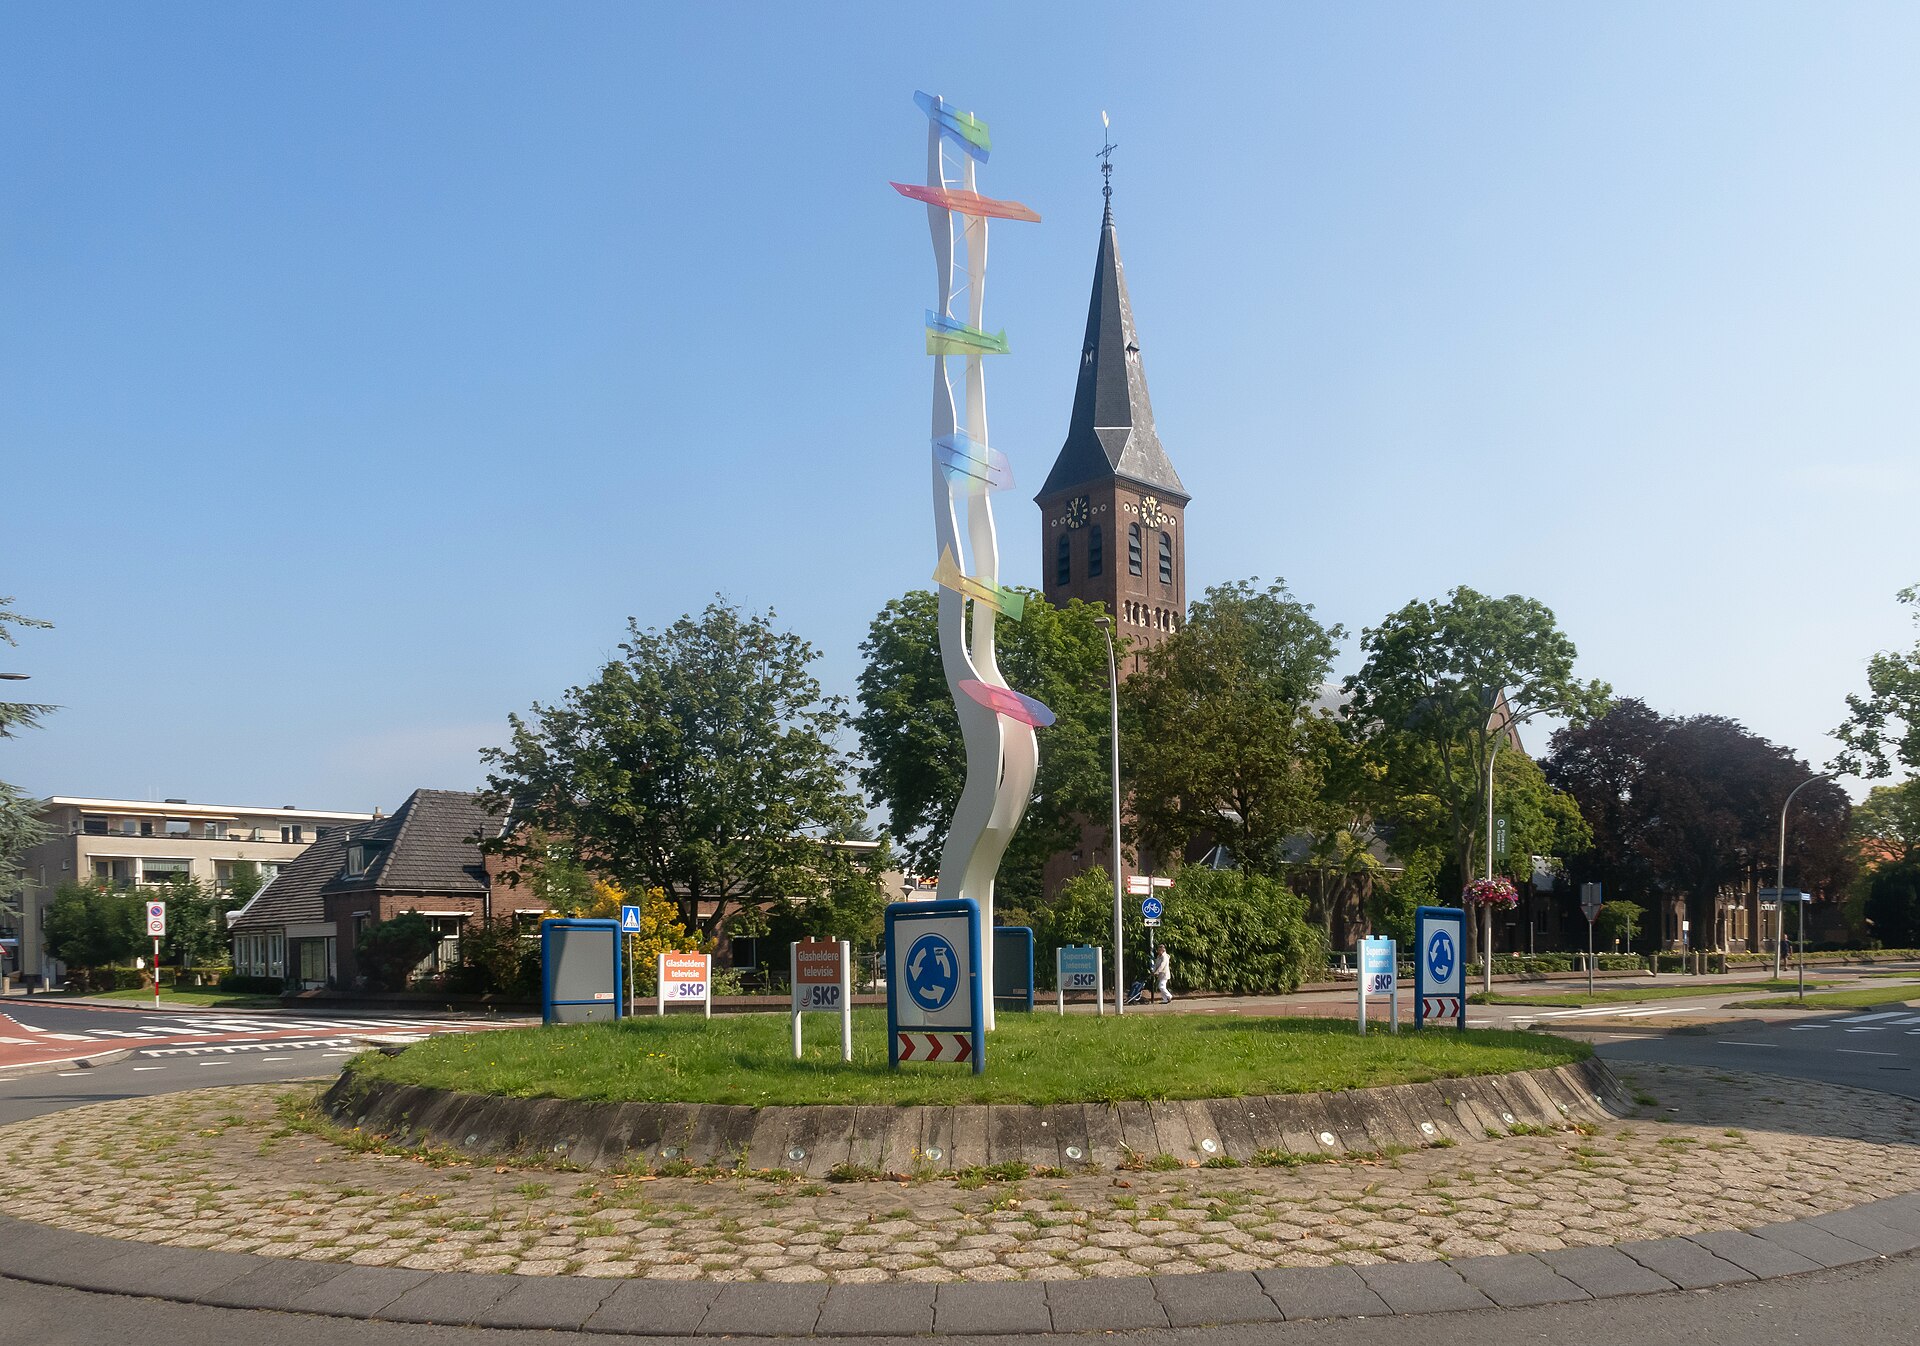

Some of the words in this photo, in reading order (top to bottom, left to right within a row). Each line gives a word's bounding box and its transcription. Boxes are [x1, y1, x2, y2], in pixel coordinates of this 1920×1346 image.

[798, 950, 840, 962] Glasheldere
[1063, 952, 1094, 961] Supersnel
[1365, 946, 1391, 957] Supersnel
[665, 959, 705, 968] Glasheldere
[1065, 961, 1092, 969] internet
[1368, 958, 1390, 968] internet
[671, 969, 700, 978] televisie
[803, 965, 834, 977] televisie
[1073, 973, 1096, 986] SKP
[1375, 974, 1392, 990] SKP
[679, 983, 705, 996] SKP
[812, 985, 840, 1006] SKP
